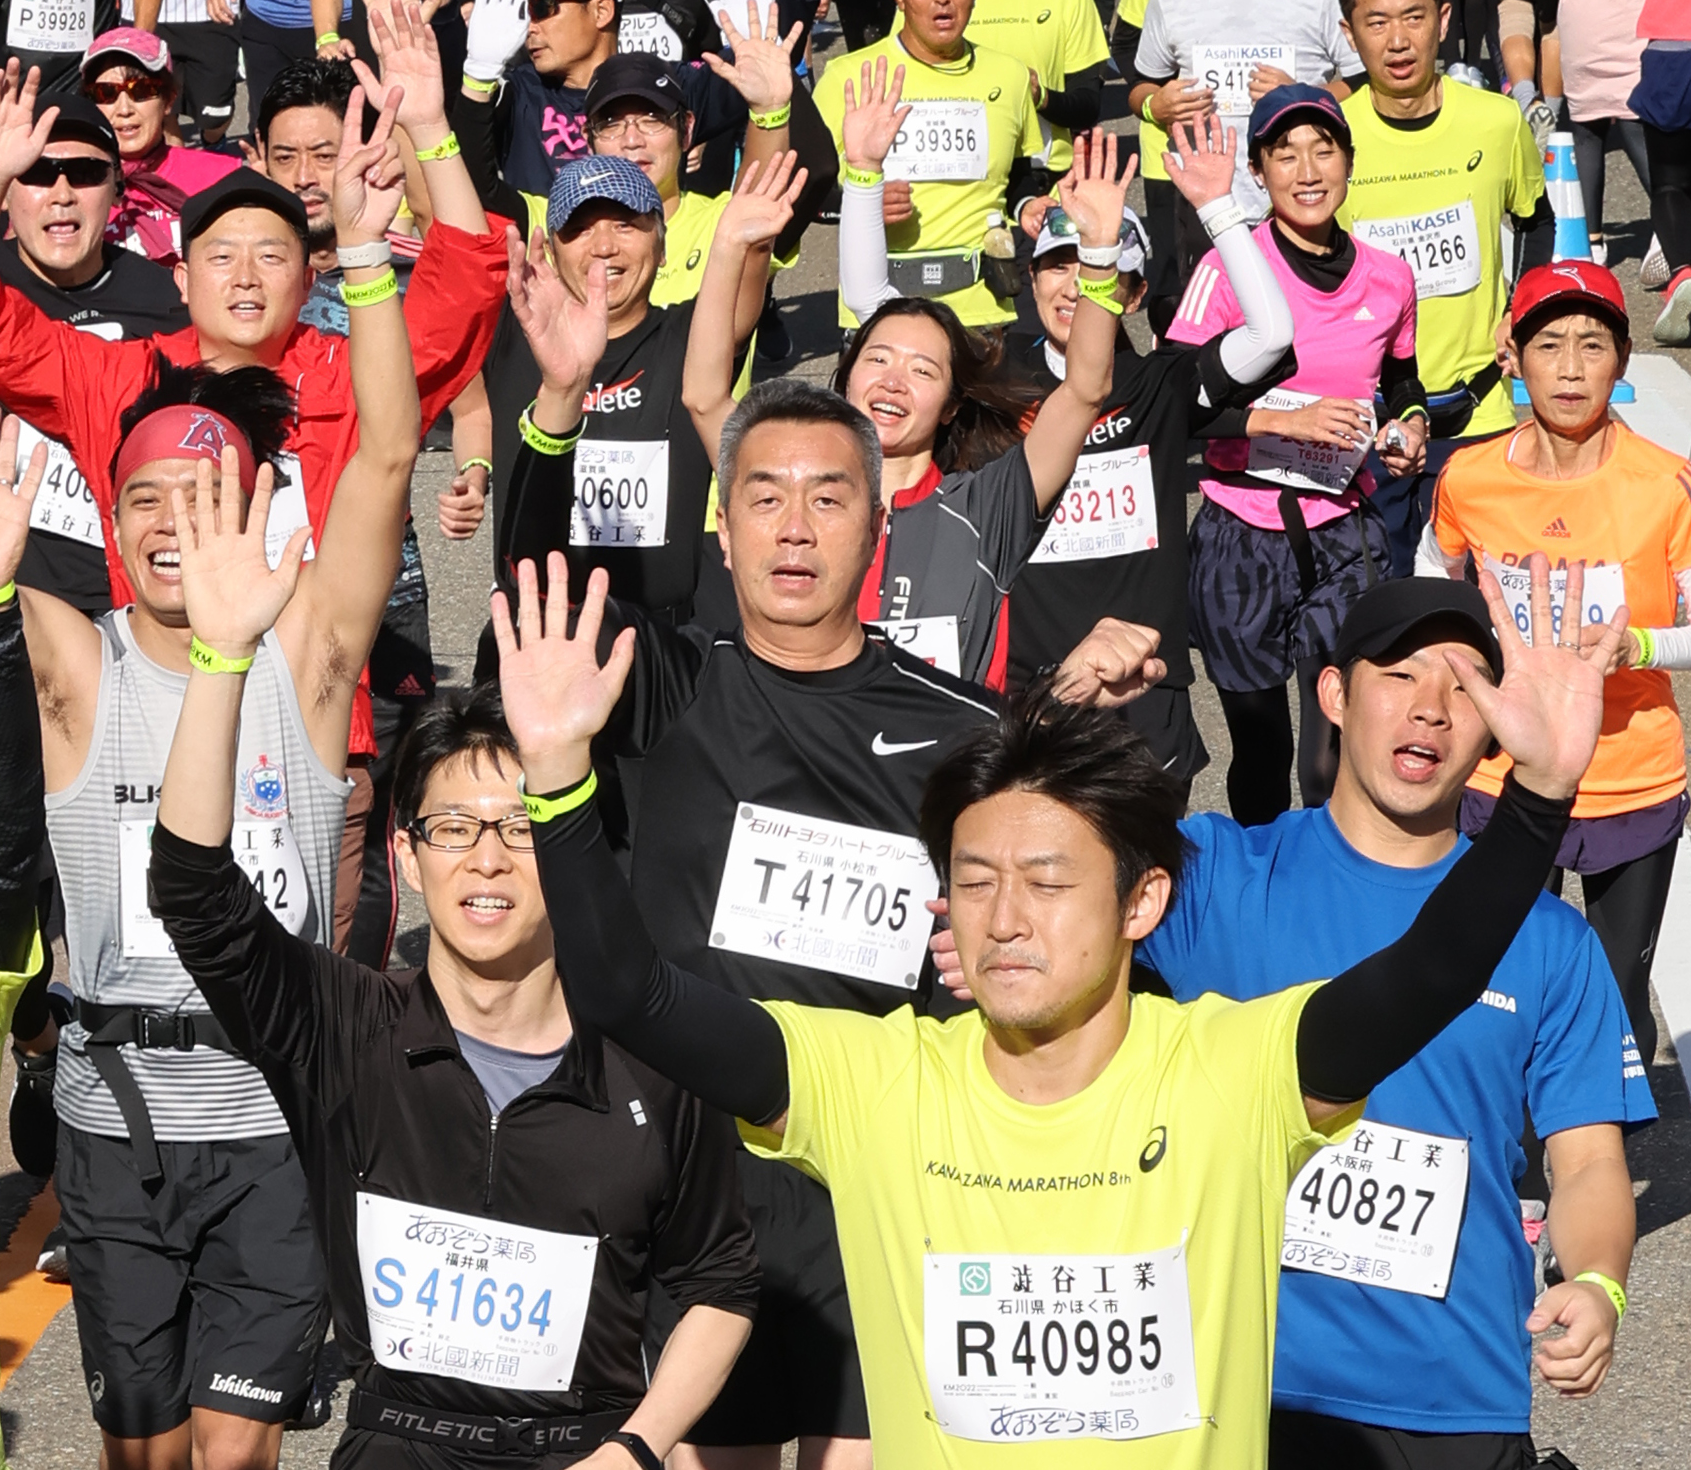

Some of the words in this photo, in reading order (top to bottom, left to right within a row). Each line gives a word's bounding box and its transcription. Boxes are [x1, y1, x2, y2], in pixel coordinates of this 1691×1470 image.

[1205, 48, 1283, 60] AsahiKASEI
[1400, 169, 1445, 183] MARATHON
[1368, 209, 1461, 239] AsahiKASEI
[574, 477, 649, 510] 0600
[797, 850, 836, 869] 石川県
[840, 859, 879, 878] 小松市
[790, 931, 879, 968] 北國新聞
[925, 1160, 1003, 1191] KANAZAWA
[1007, 1172, 1104, 1192] MARATHON
[1109, 1171, 1132, 1187] 8th
[1329, 1151, 1375, 1174] 大阪府
[1300, 1166, 1436, 1237] 40827
[405, 1212, 537, 1264] あおぞら薬局
[445, 1251, 490, 1272] 福井県
[1011, 1262, 1157, 1294] 澁谷工業
[372, 1257, 553, 1338] S41634
[997, 1299, 1046, 1316] 石川県
[1053, 1299, 1119, 1316] かほく市
[418, 1341, 521, 1378] 北國新聞
[956, 1314, 1163, 1378] R40985
[209, 1373, 284, 1405] Ishikawa
[380, 1407, 496, 1443] FITLETIC
[990, 1405, 1140, 1438] あおぞら薬局
